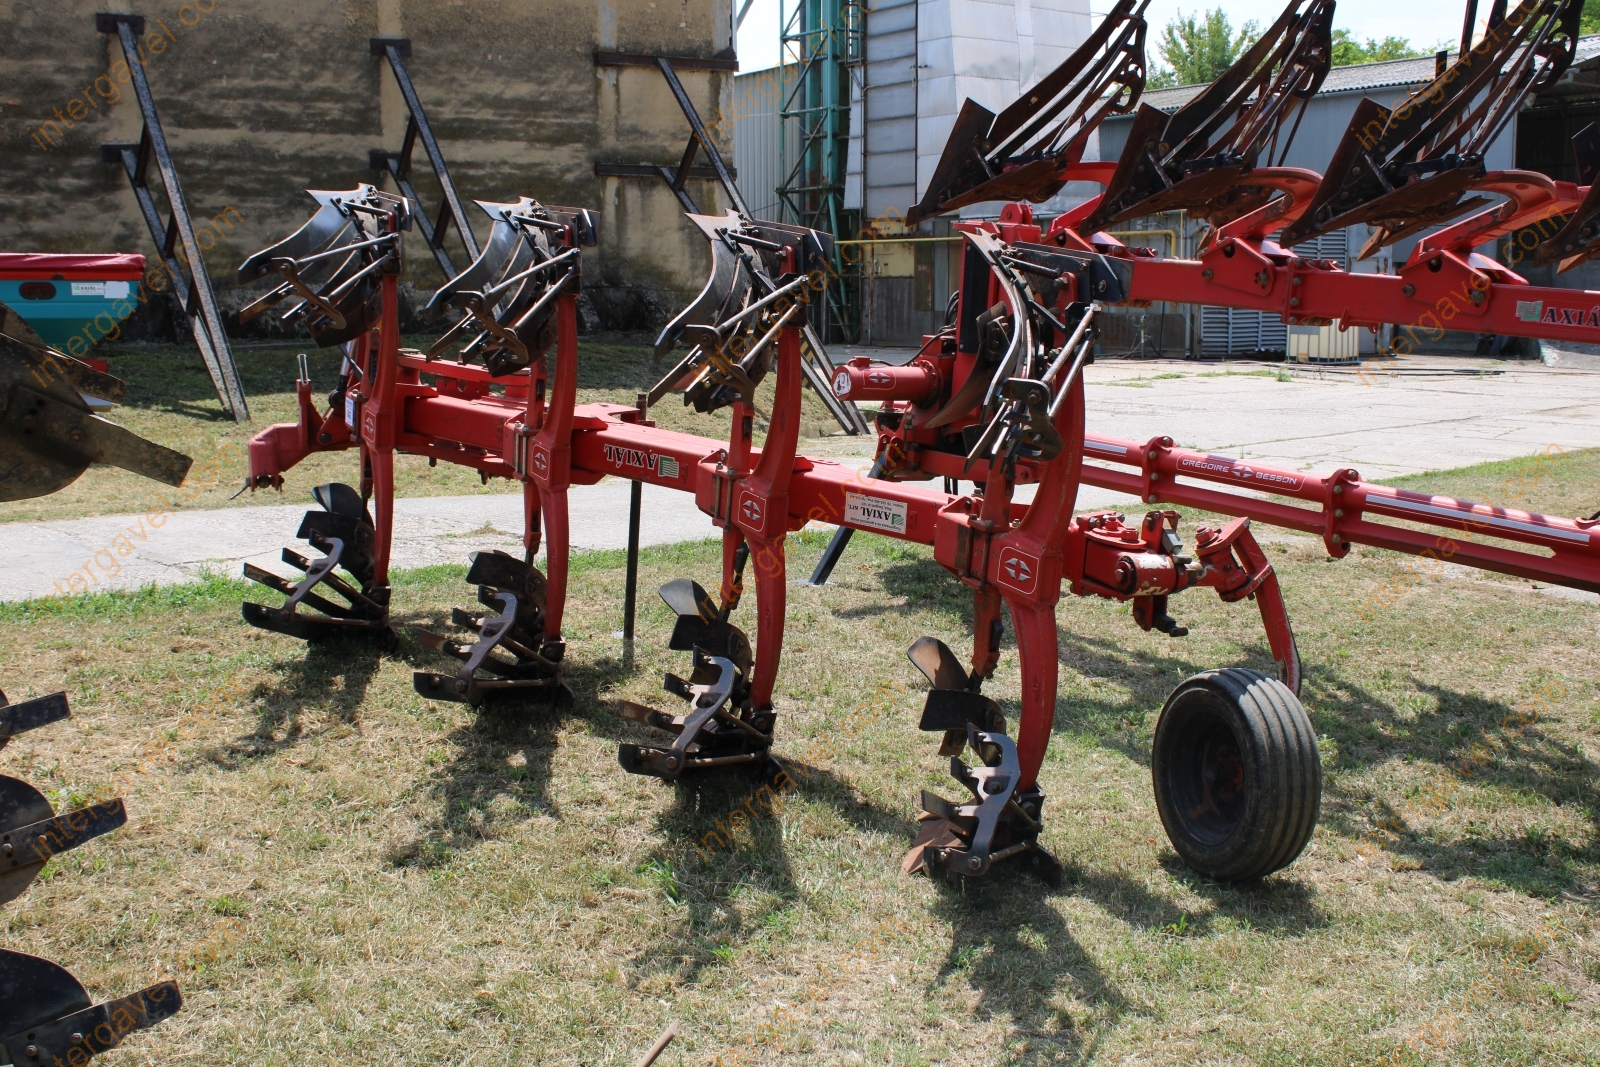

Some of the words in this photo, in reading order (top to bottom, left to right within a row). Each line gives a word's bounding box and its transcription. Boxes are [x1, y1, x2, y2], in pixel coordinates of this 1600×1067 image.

[1541, 305, 1600, 329] AXIÁ
[604, 443, 658, 470] AXIÁL
[1255, 471, 1298, 485] BESSON
[860, 506, 890, 521] AXIÁL
